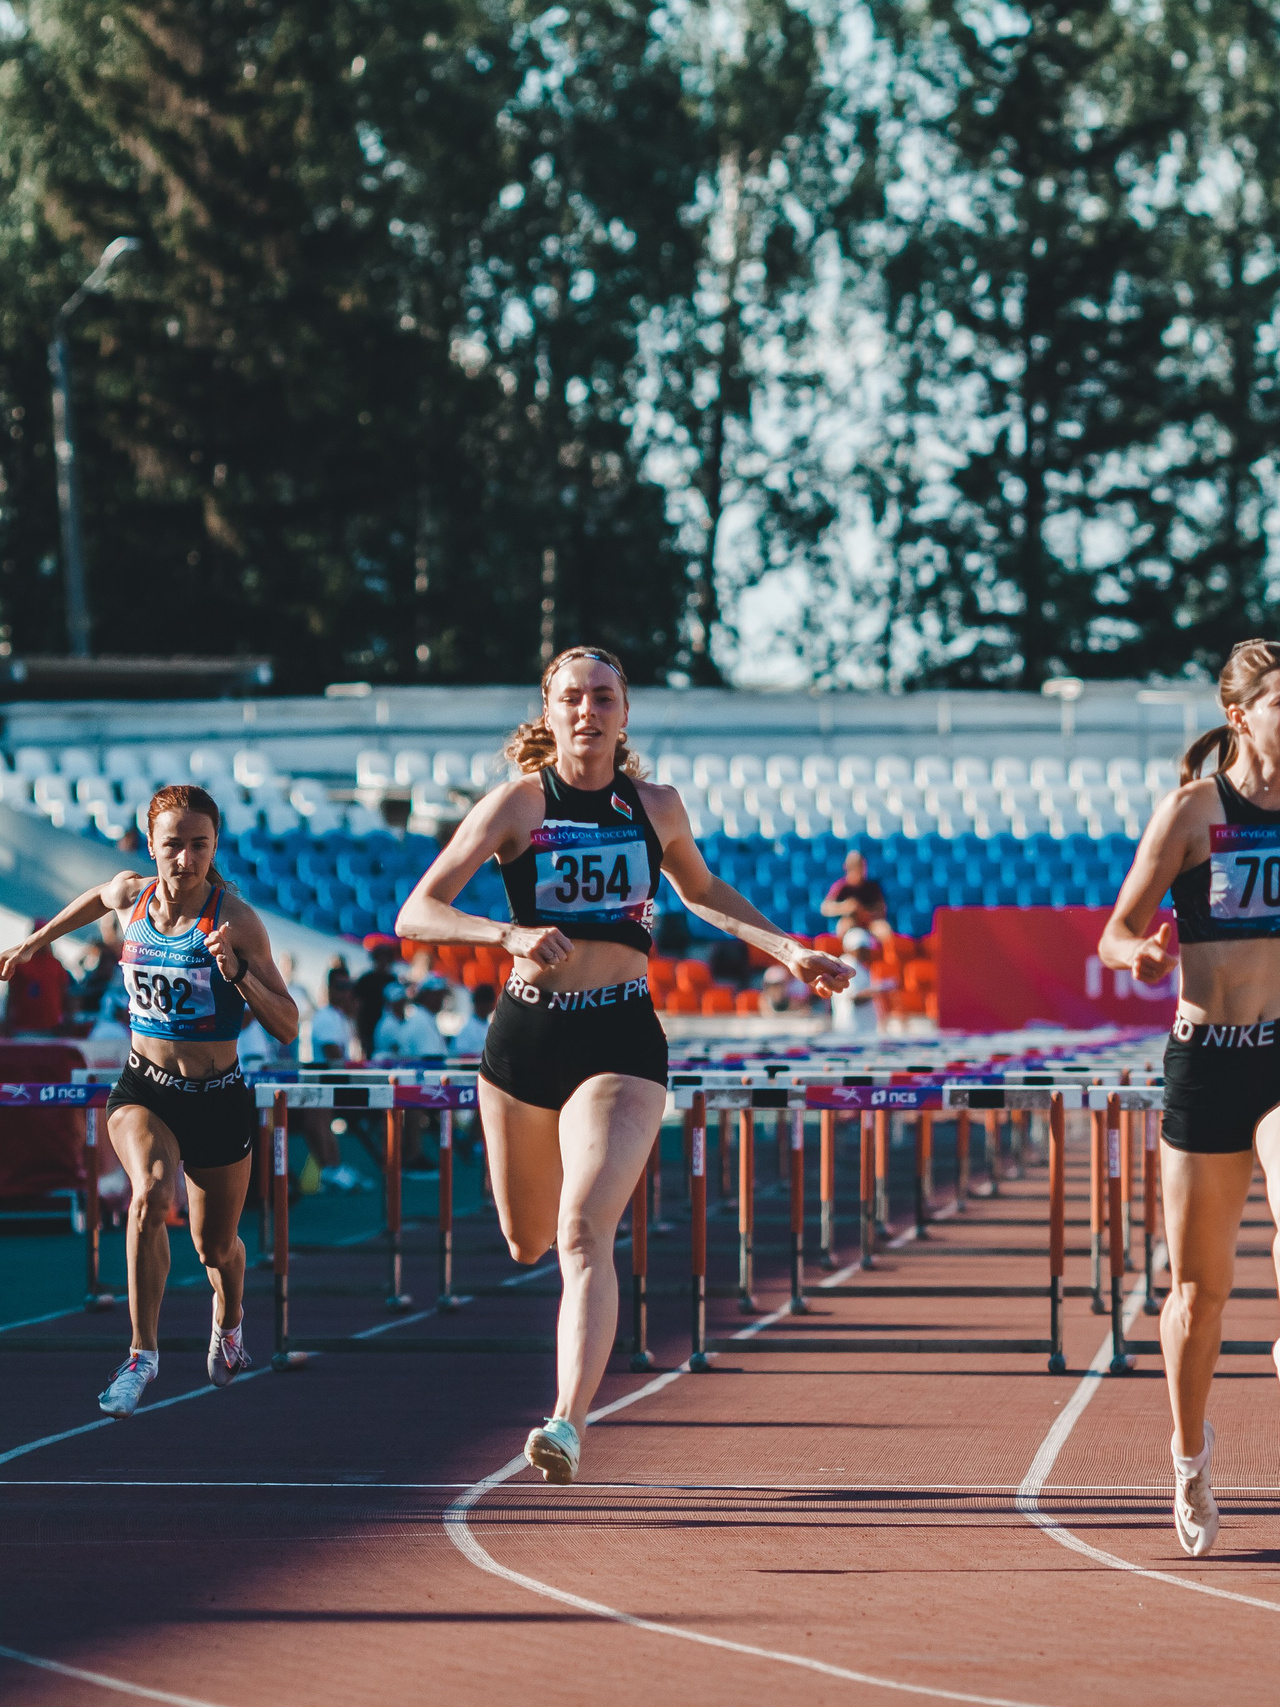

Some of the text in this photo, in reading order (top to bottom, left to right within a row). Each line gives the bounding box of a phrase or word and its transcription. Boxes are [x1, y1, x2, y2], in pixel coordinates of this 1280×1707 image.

[534, 829, 638, 841] ПСБ КУБОК РОССИИ
[1240, 829, 1277, 839] КУБОК
[555, 854, 632, 904] 354
[125, 944, 138, 953] ПСБ
[139, 947, 167, 958] КУБОК
[133, 969, 196, 1015] 582
[547, 985, 618, 1011] NIKE
[623, 975, 648, 1001] PR
[1202, 1021, 1275, 1048] NIKE
[144, 1065, 200, 1093] NIKE
[57, 1088, 86, 1099] ПСБ
[888, 1092, 917, 1103] ПСБ
